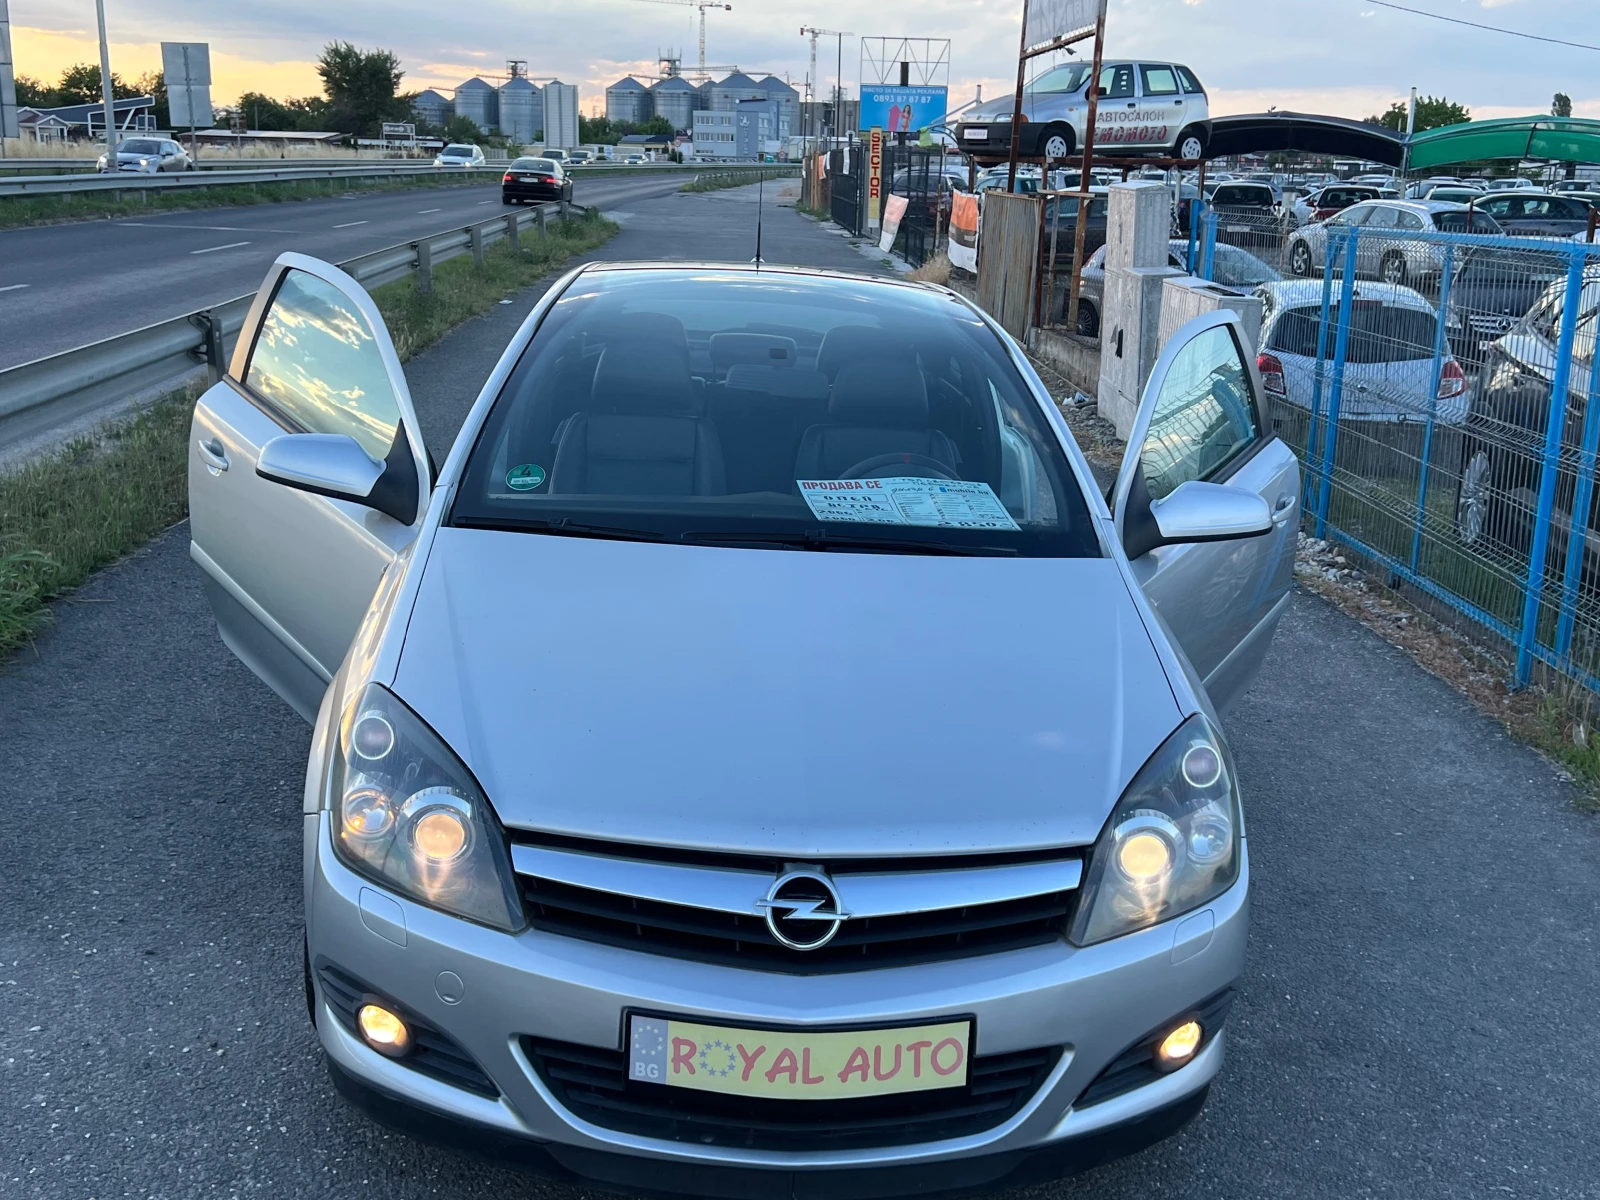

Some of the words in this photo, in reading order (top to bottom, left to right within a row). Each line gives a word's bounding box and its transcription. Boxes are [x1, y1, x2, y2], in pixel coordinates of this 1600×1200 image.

[873, 94, 895, 103] 0893
[896, 95, 907, 103] 87
[908, 95, 919, 103] 87
[920, 96, 932, 104] 87
[1097, 111, 1165, 122] АВТОСАЛОН
[870, 132, 881, 199] SECTOR
[520, 465, 532, 477] 4
[802, 481, 864, 491] ПРОДАВА
[865, 480, 883, 489] СЕ
[837, 1037, 964, 1083] AUTO
[635, 1062, 659, 1079] BG
